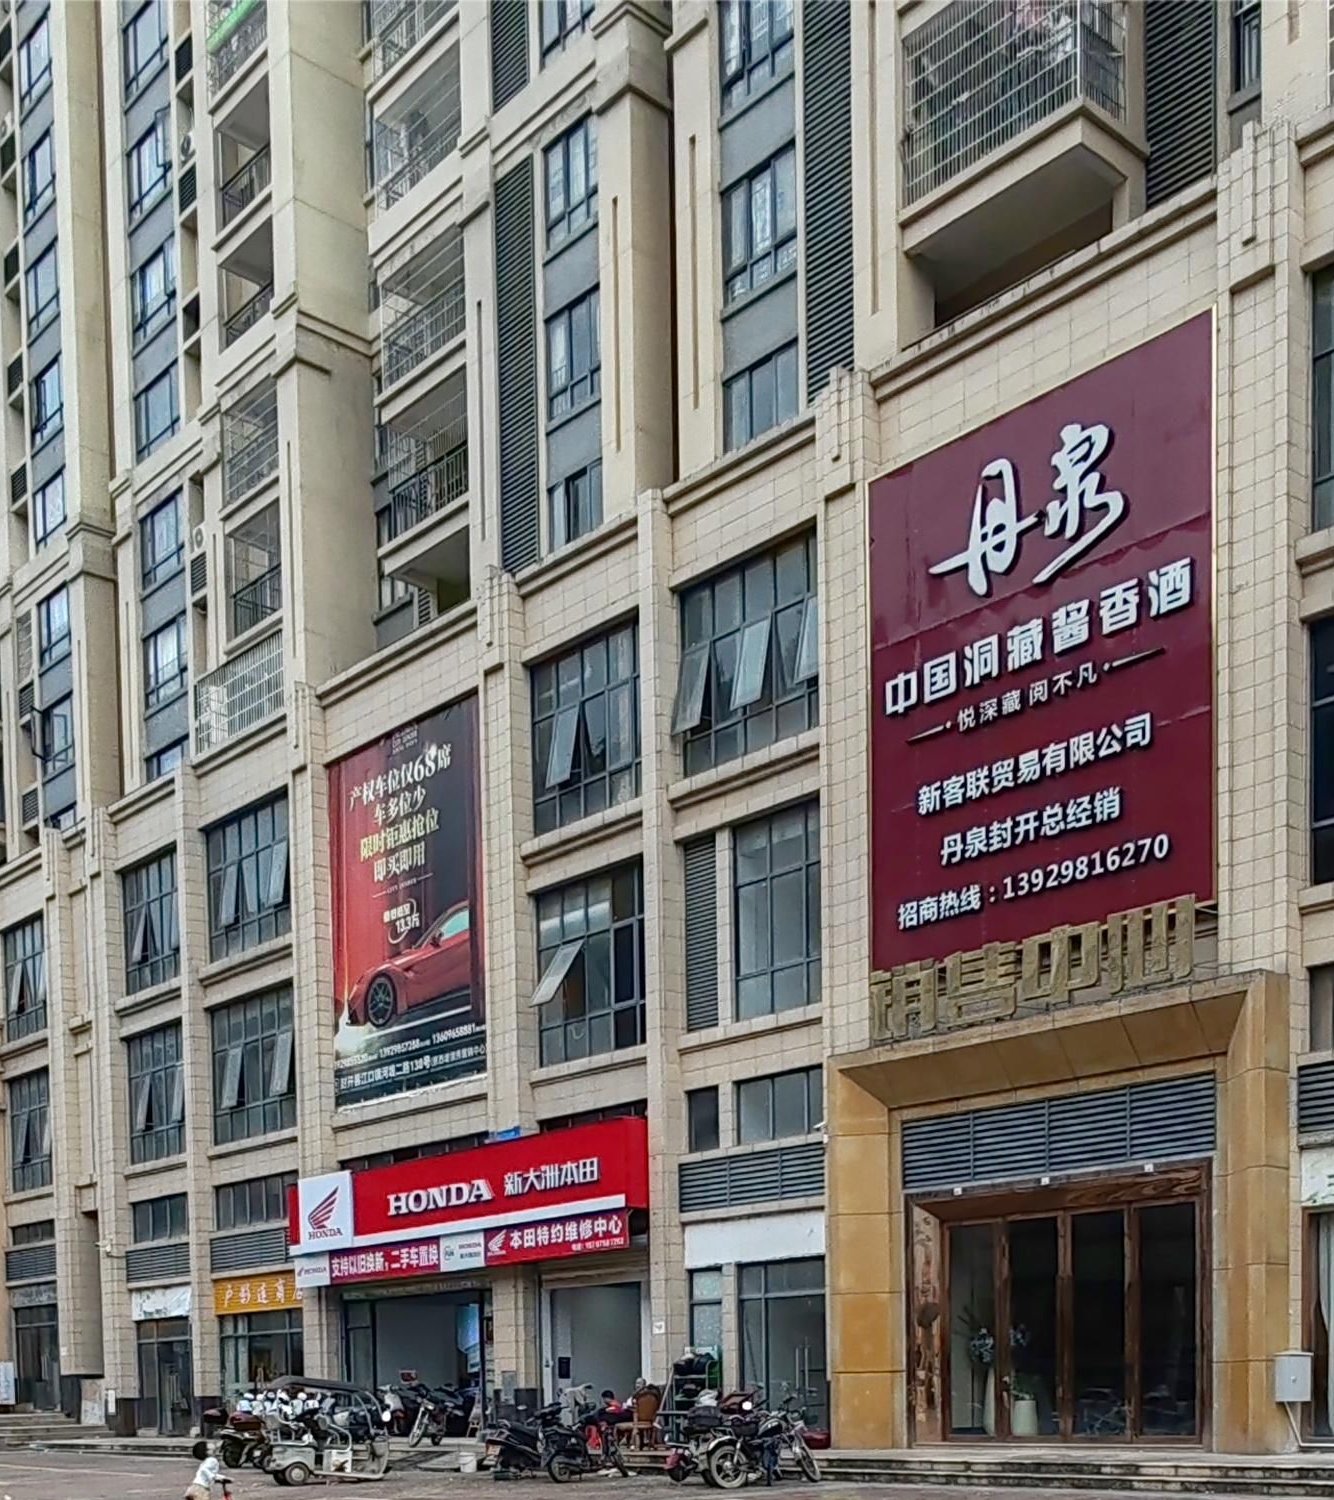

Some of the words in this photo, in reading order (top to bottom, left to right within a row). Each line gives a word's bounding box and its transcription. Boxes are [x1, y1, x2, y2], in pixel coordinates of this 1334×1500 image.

[929, 423, 1126, 597] 丹泉
[884, 556, 1193, 717] 中国洞藏酱香酒
[956, 688, 1023, 733] 悦深藏
[1027, 659, 1100, 706] 阅不凡
[916, 711, 1152, 817] 新客联贸易有限公司
[373, 786, 427, 828] 车多位少
[940, 786, 1121, 868] 丹泉封开总经销
[373, 845, 426, 884] 即买即用
[868, 893, 1196, 1043] 销售中心
[387, 1178, 494, 1218] HONDA
[503, 1157, 599, 1197] 新大洲本田
[307, 1227, 343, 1241] HONDA
[509, 1214, 623, 1250] 本田特约维修中心
